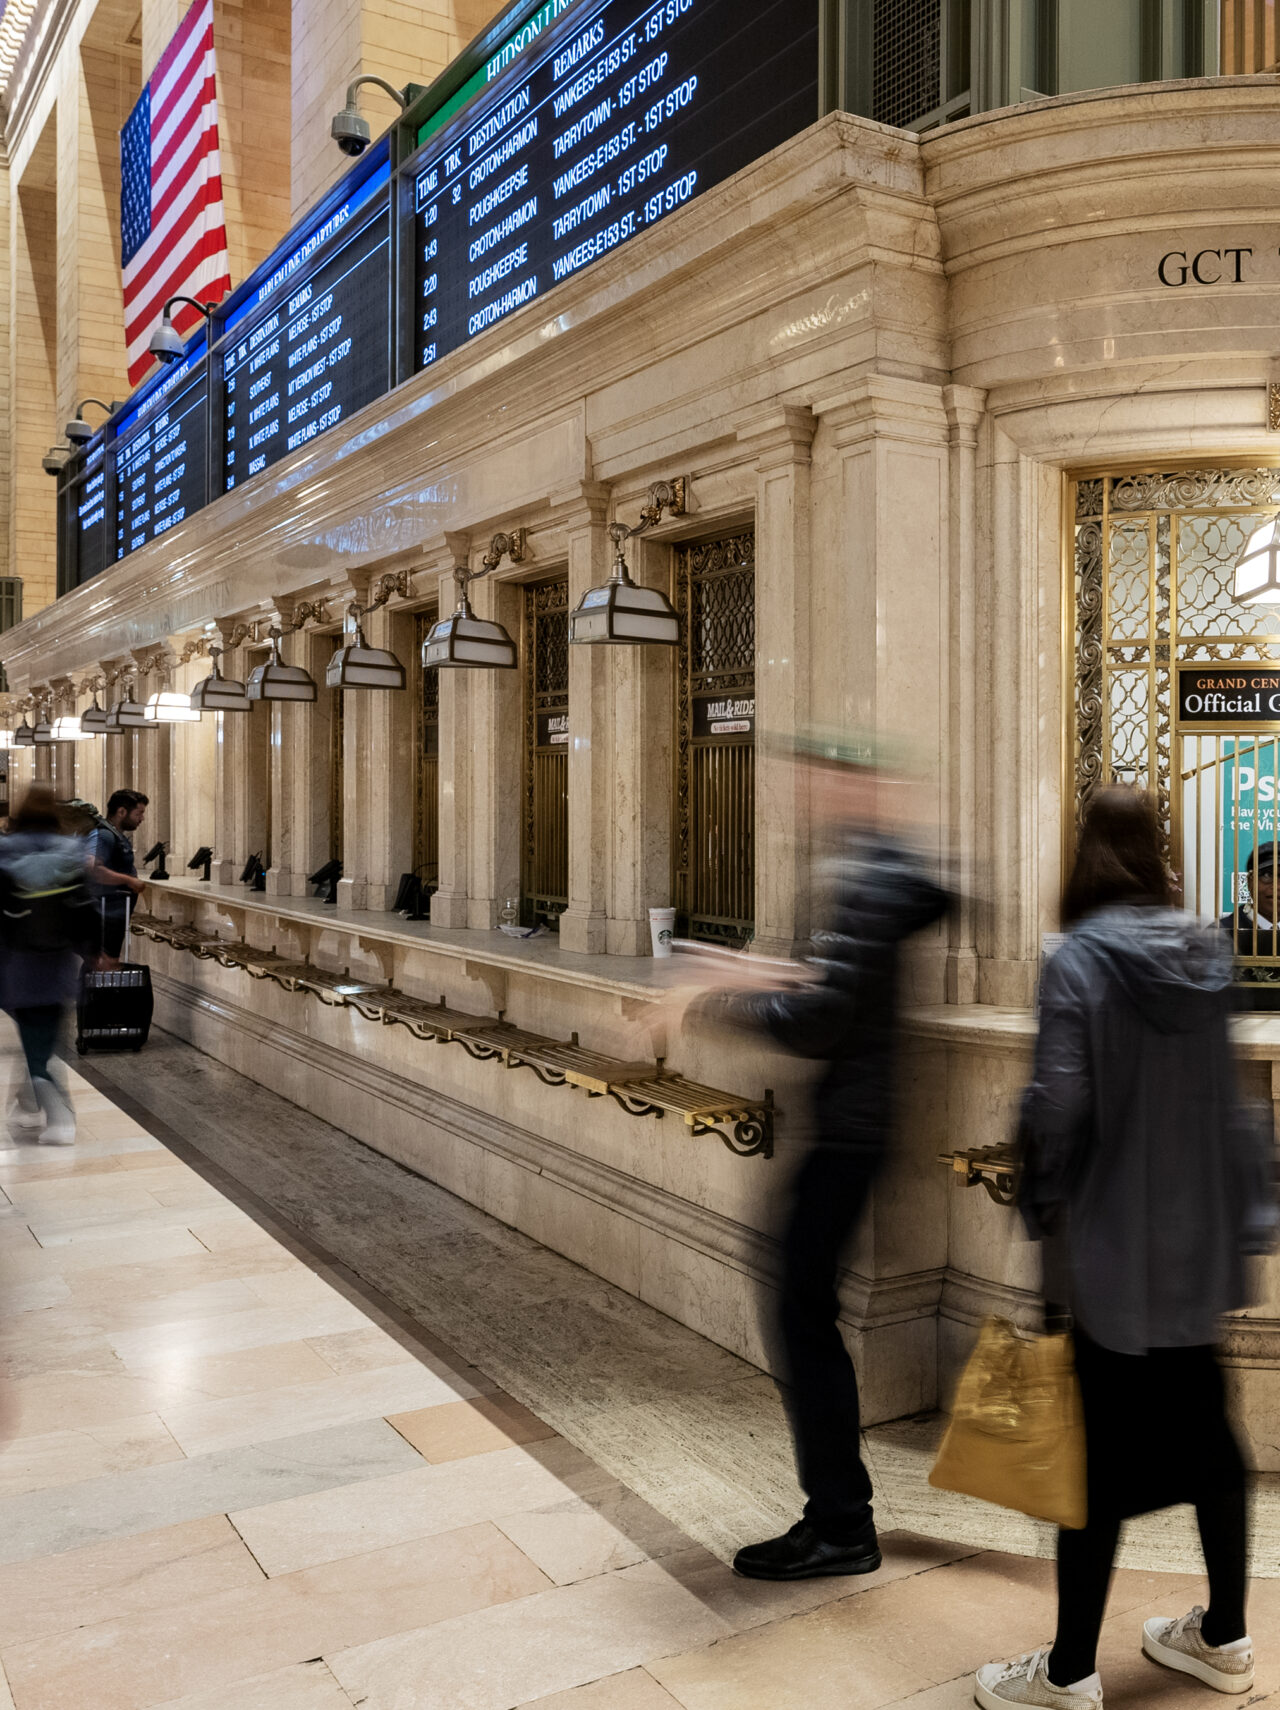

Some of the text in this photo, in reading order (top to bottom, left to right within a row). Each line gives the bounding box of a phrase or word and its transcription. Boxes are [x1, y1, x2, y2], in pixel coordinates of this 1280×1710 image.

[418, 18, 604, 200] TIME TRK DESTINATION REMARKS
[424, 204, 438, 228] 1:20
[452, 184, 462, 205] 32
[470, 117, 538, 190] CROTON-HARMON
[553, 48, 620, 118] YANKEES-E153
[621, 32, 636, 62] ST.
[644, 8, 665, 42] 1ST
[666, 0, 694, 24] STO
[424, 238, 438, 262] 1:43
[469, 164, 528, 226] POUGHKEEPSIE
[552, 98, 611, 159] TARRYTOWN
[618, 76, 638, 108] 1ST
[638, 52, 668, 93] STOP
[469, 196, 538, 262] CROTON-HARMON
[552, 135, 620, 200] YANKEES-E153
[621, 122, 636, 151] ST.
[644, 99, 665, 132] 1ST
[666, 75, 698, 118] STOP
[424, 308, 437, 331] 2:43
[469, 242, 528, 299] POUGHKEEPSIE
[552, 184, 610, 240] TARRYTOWN
[618, 164, 637, 196] 1ST
[638, 144, 668, 183] STOP
[468, 276, 537, 336] CROTON-HARMON
[552, 222, 620, 280] YANKEES-E153
[620, 210, 636, 238] ST.
[644, 191, 664, 224] 1ST
[666, 170, 698, 210] STOP
[1157, 248, 1252, 286] GCT
[320, 294, 333, 316] STOP
[328, 315, 342, 338] STOP
[338, 338, 352, 360] STOP
[320, 381, 332, 403] STOP
[328, 404, 342, 426] STOP
[1196, 678, 1246, 690] GRAND
[1184, 693, 1260, 714] Official
